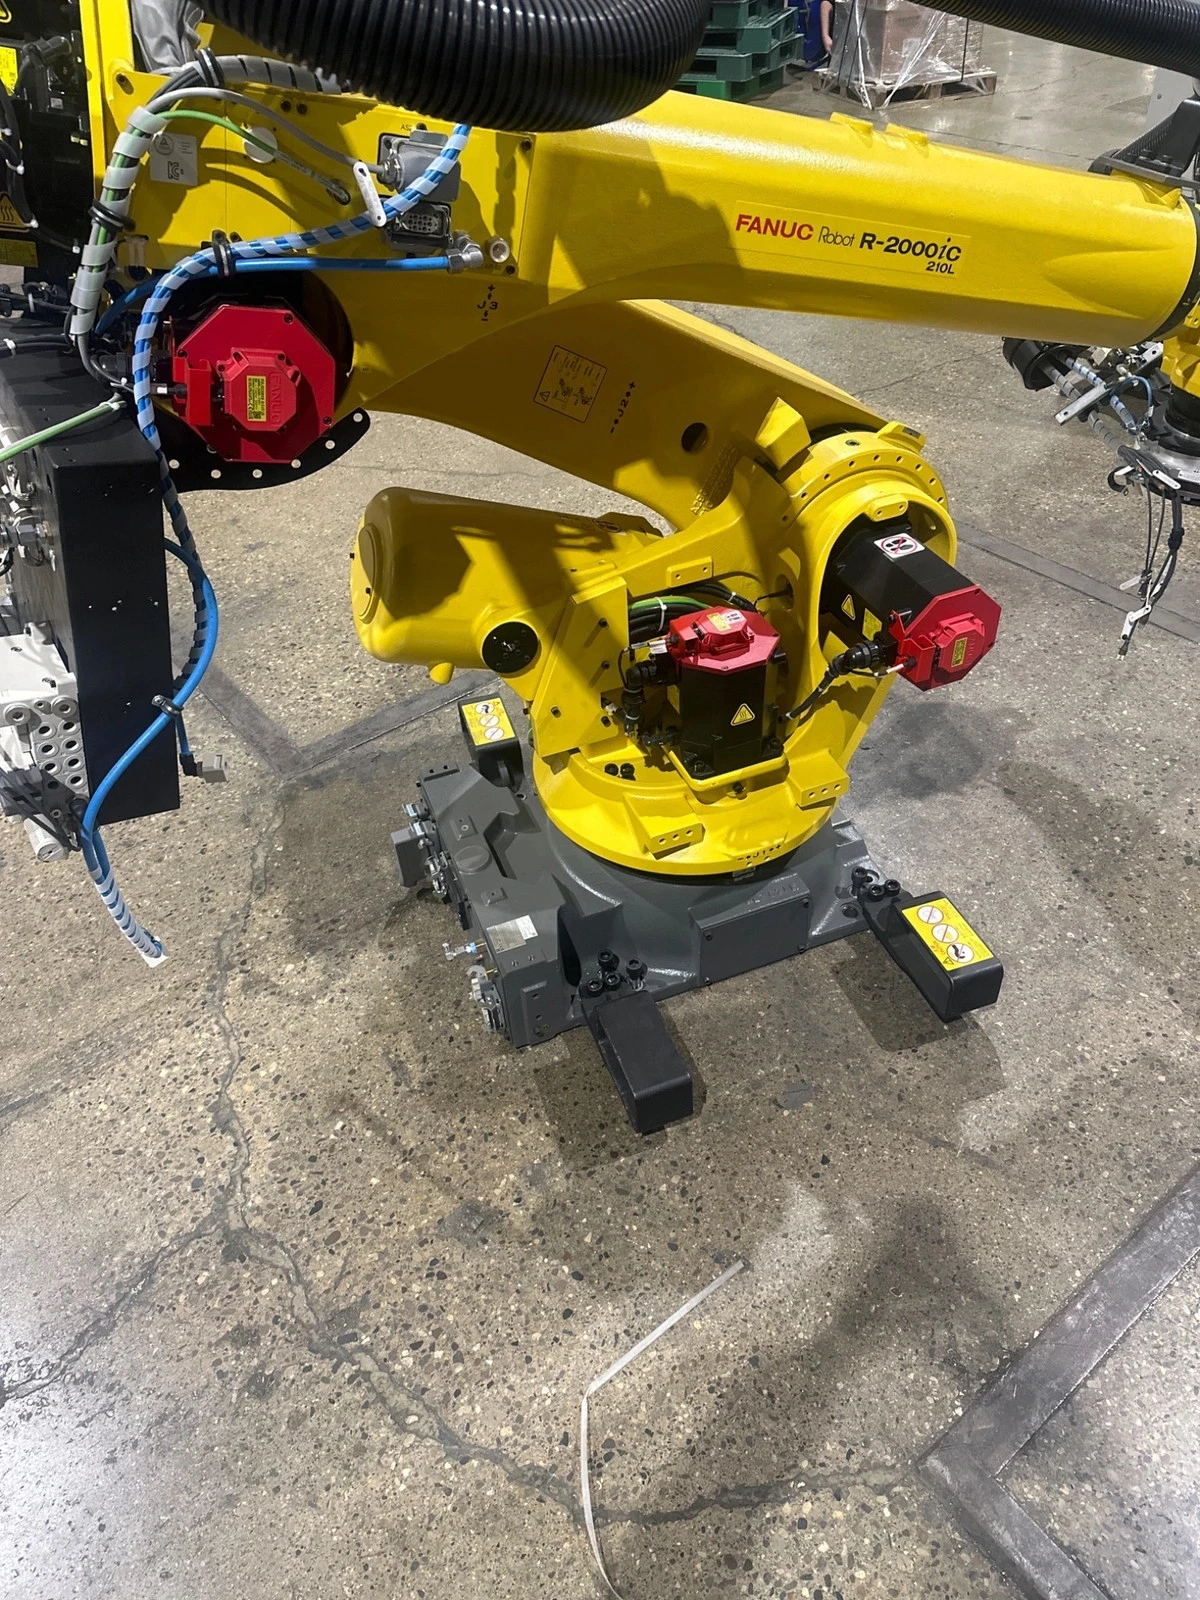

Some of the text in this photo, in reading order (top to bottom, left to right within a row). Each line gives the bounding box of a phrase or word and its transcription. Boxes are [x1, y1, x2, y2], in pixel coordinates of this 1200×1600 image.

[735, 214, 962, 262] FANUC Robot R-2000iC
[925, 261, 955, 275] 210L
